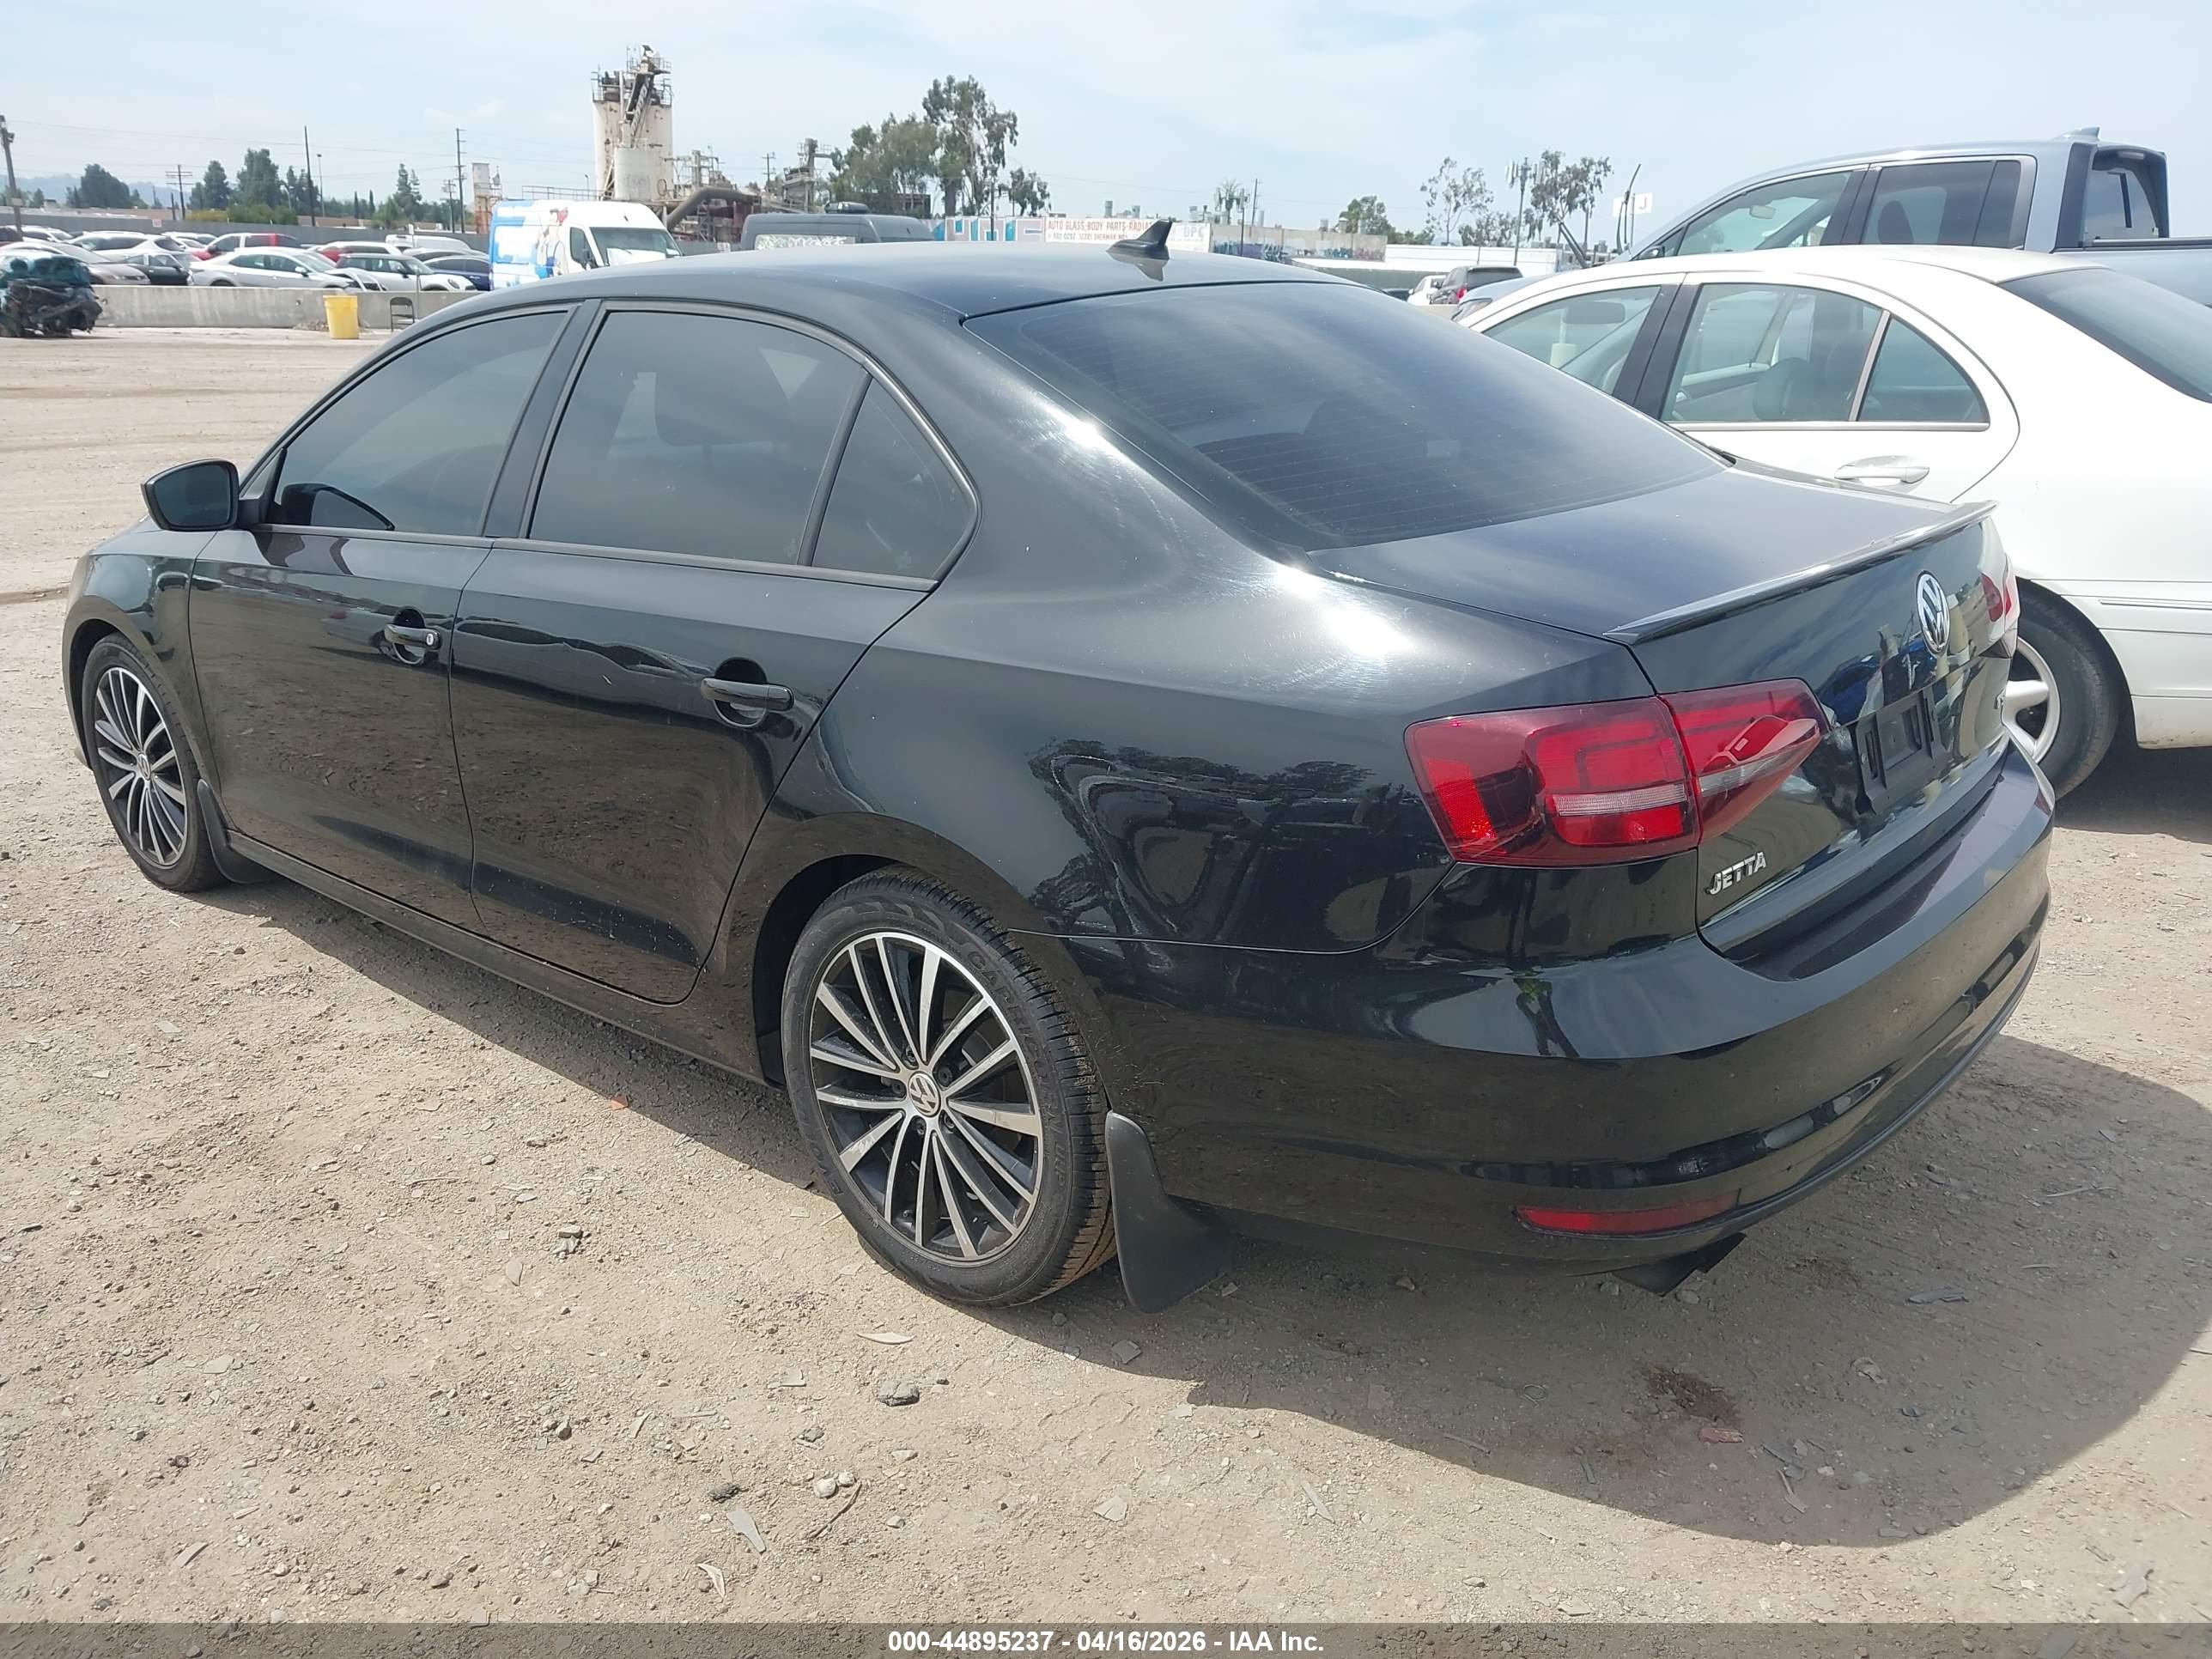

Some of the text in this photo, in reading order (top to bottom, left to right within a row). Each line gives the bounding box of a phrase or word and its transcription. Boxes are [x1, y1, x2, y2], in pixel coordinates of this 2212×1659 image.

[1639, 197, 1647, 210] J
[1048, 220, 1064, 230] AUTO
[1705, 851, 1767, 895] JETTA
